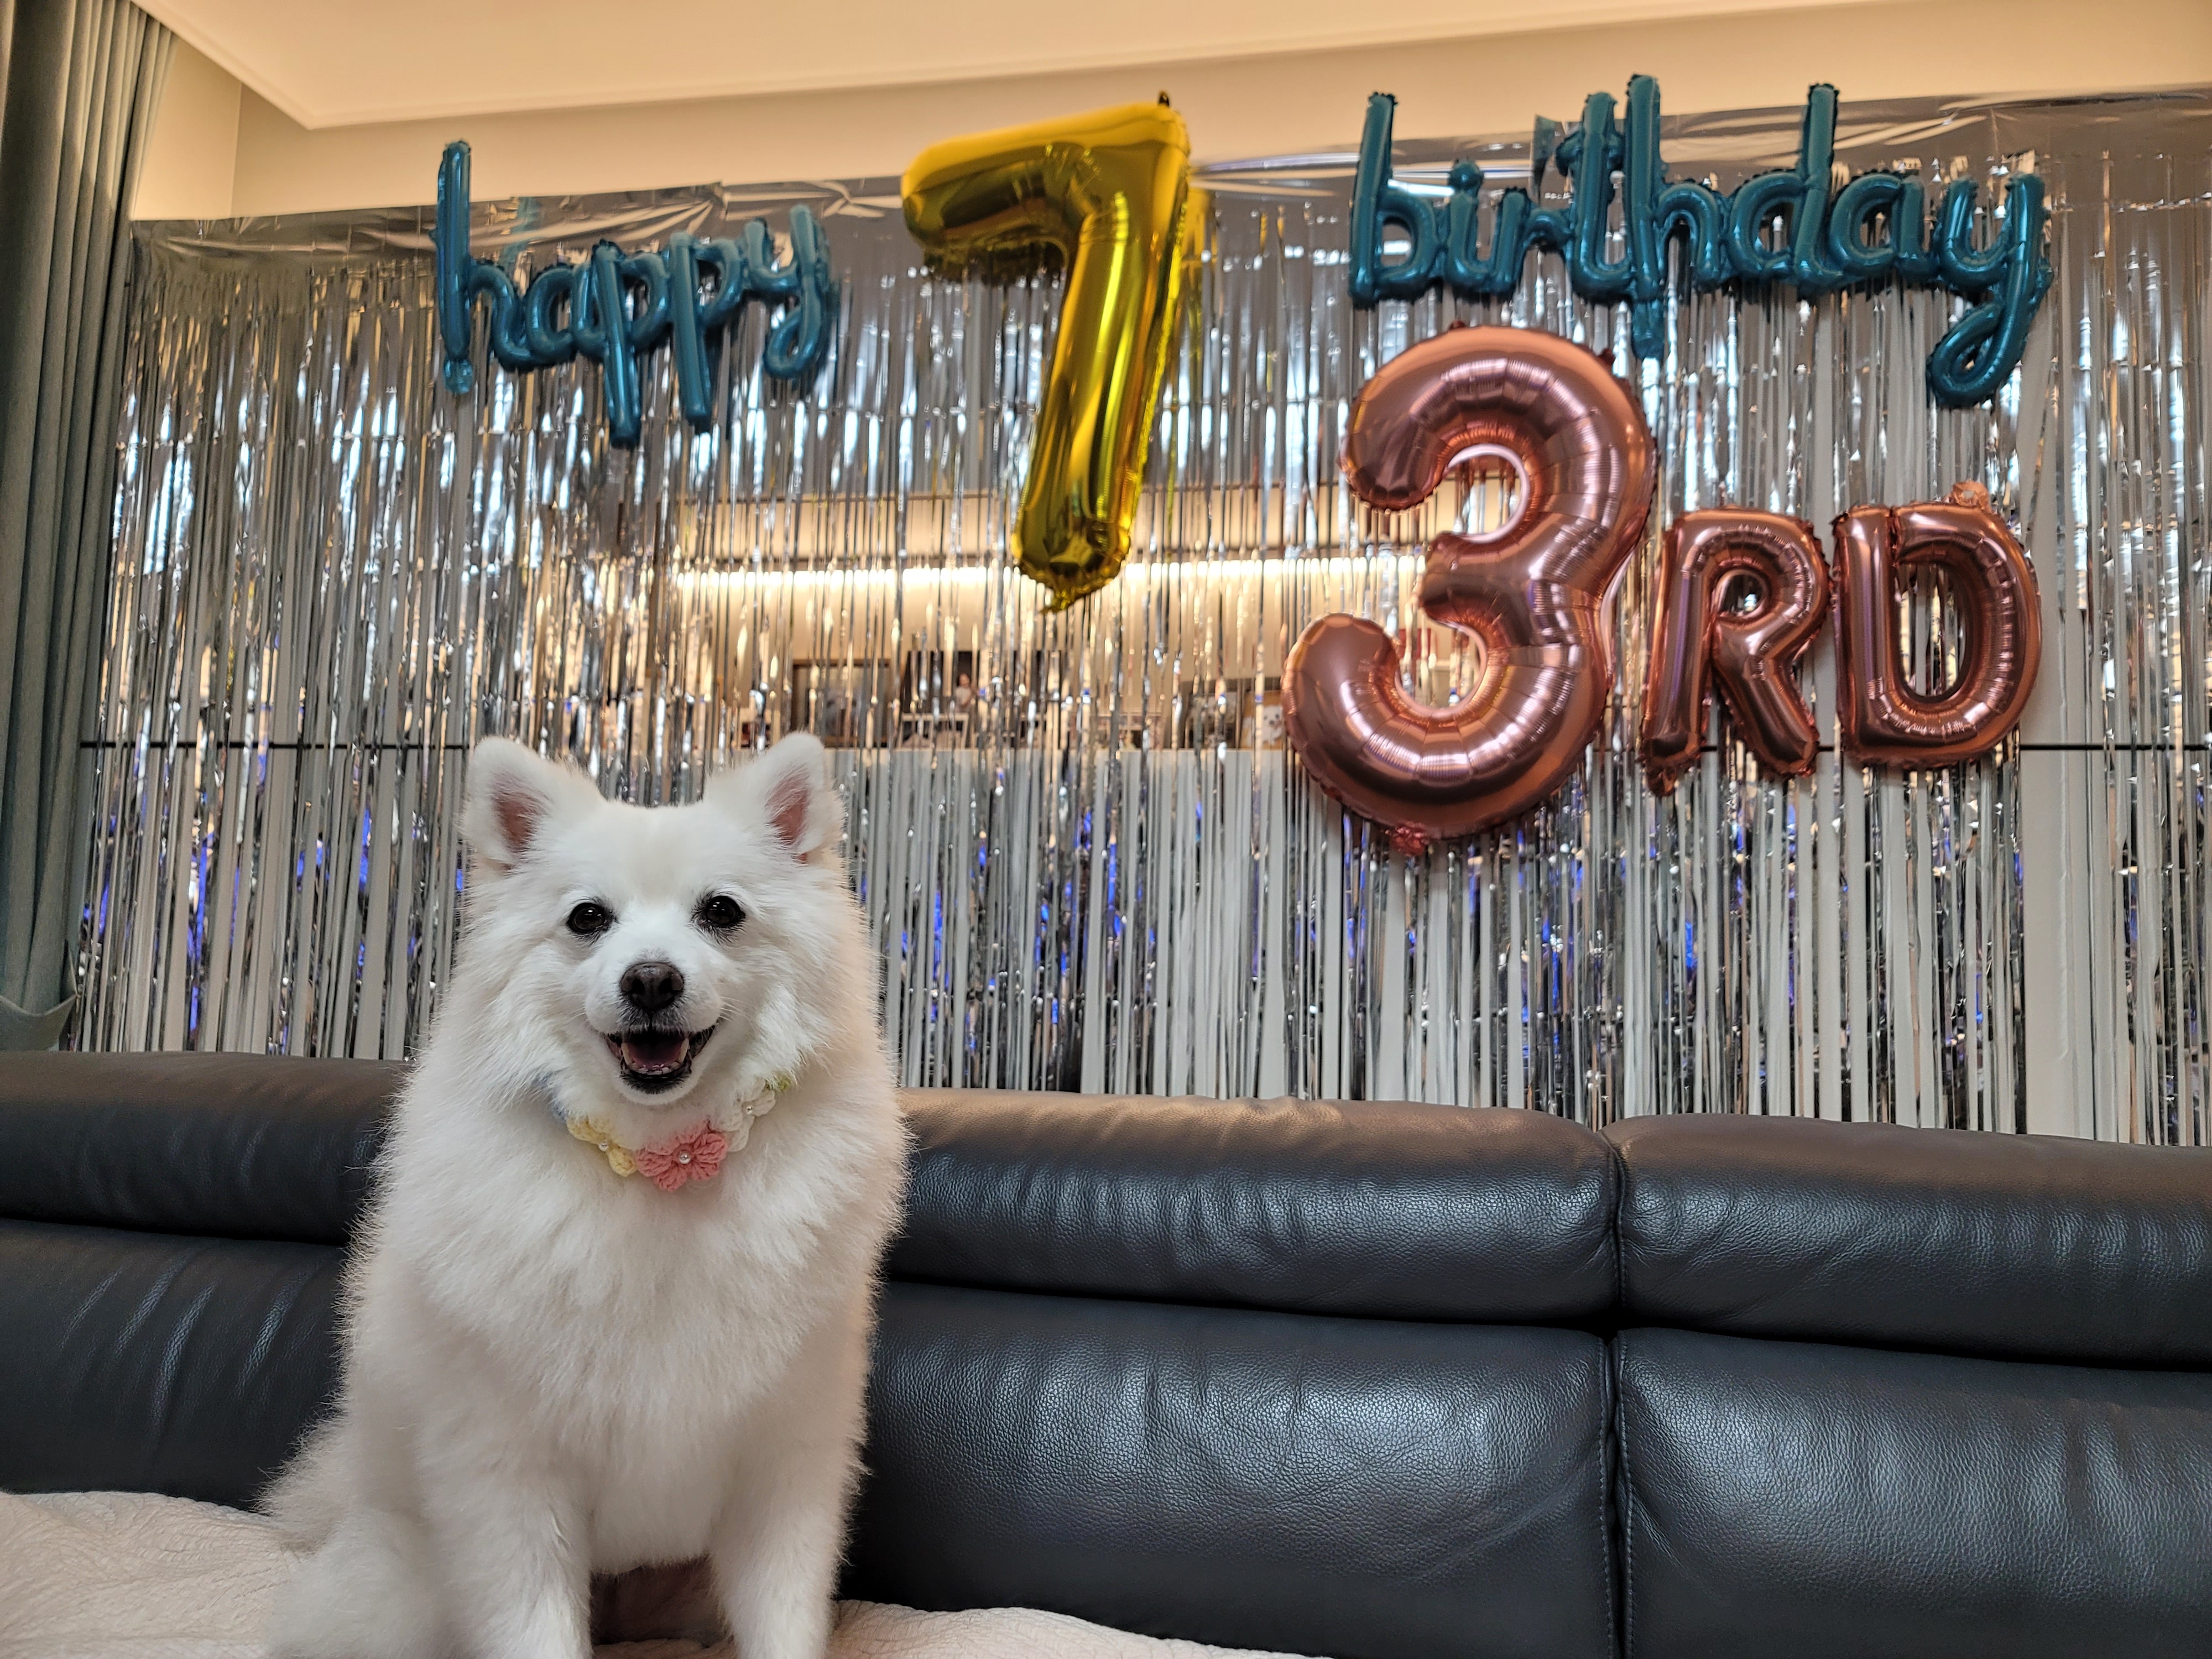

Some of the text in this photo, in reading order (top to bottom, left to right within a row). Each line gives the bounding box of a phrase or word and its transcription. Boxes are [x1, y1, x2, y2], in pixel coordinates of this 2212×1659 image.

[436, 74, 2053, 613] happy 7 birthday
